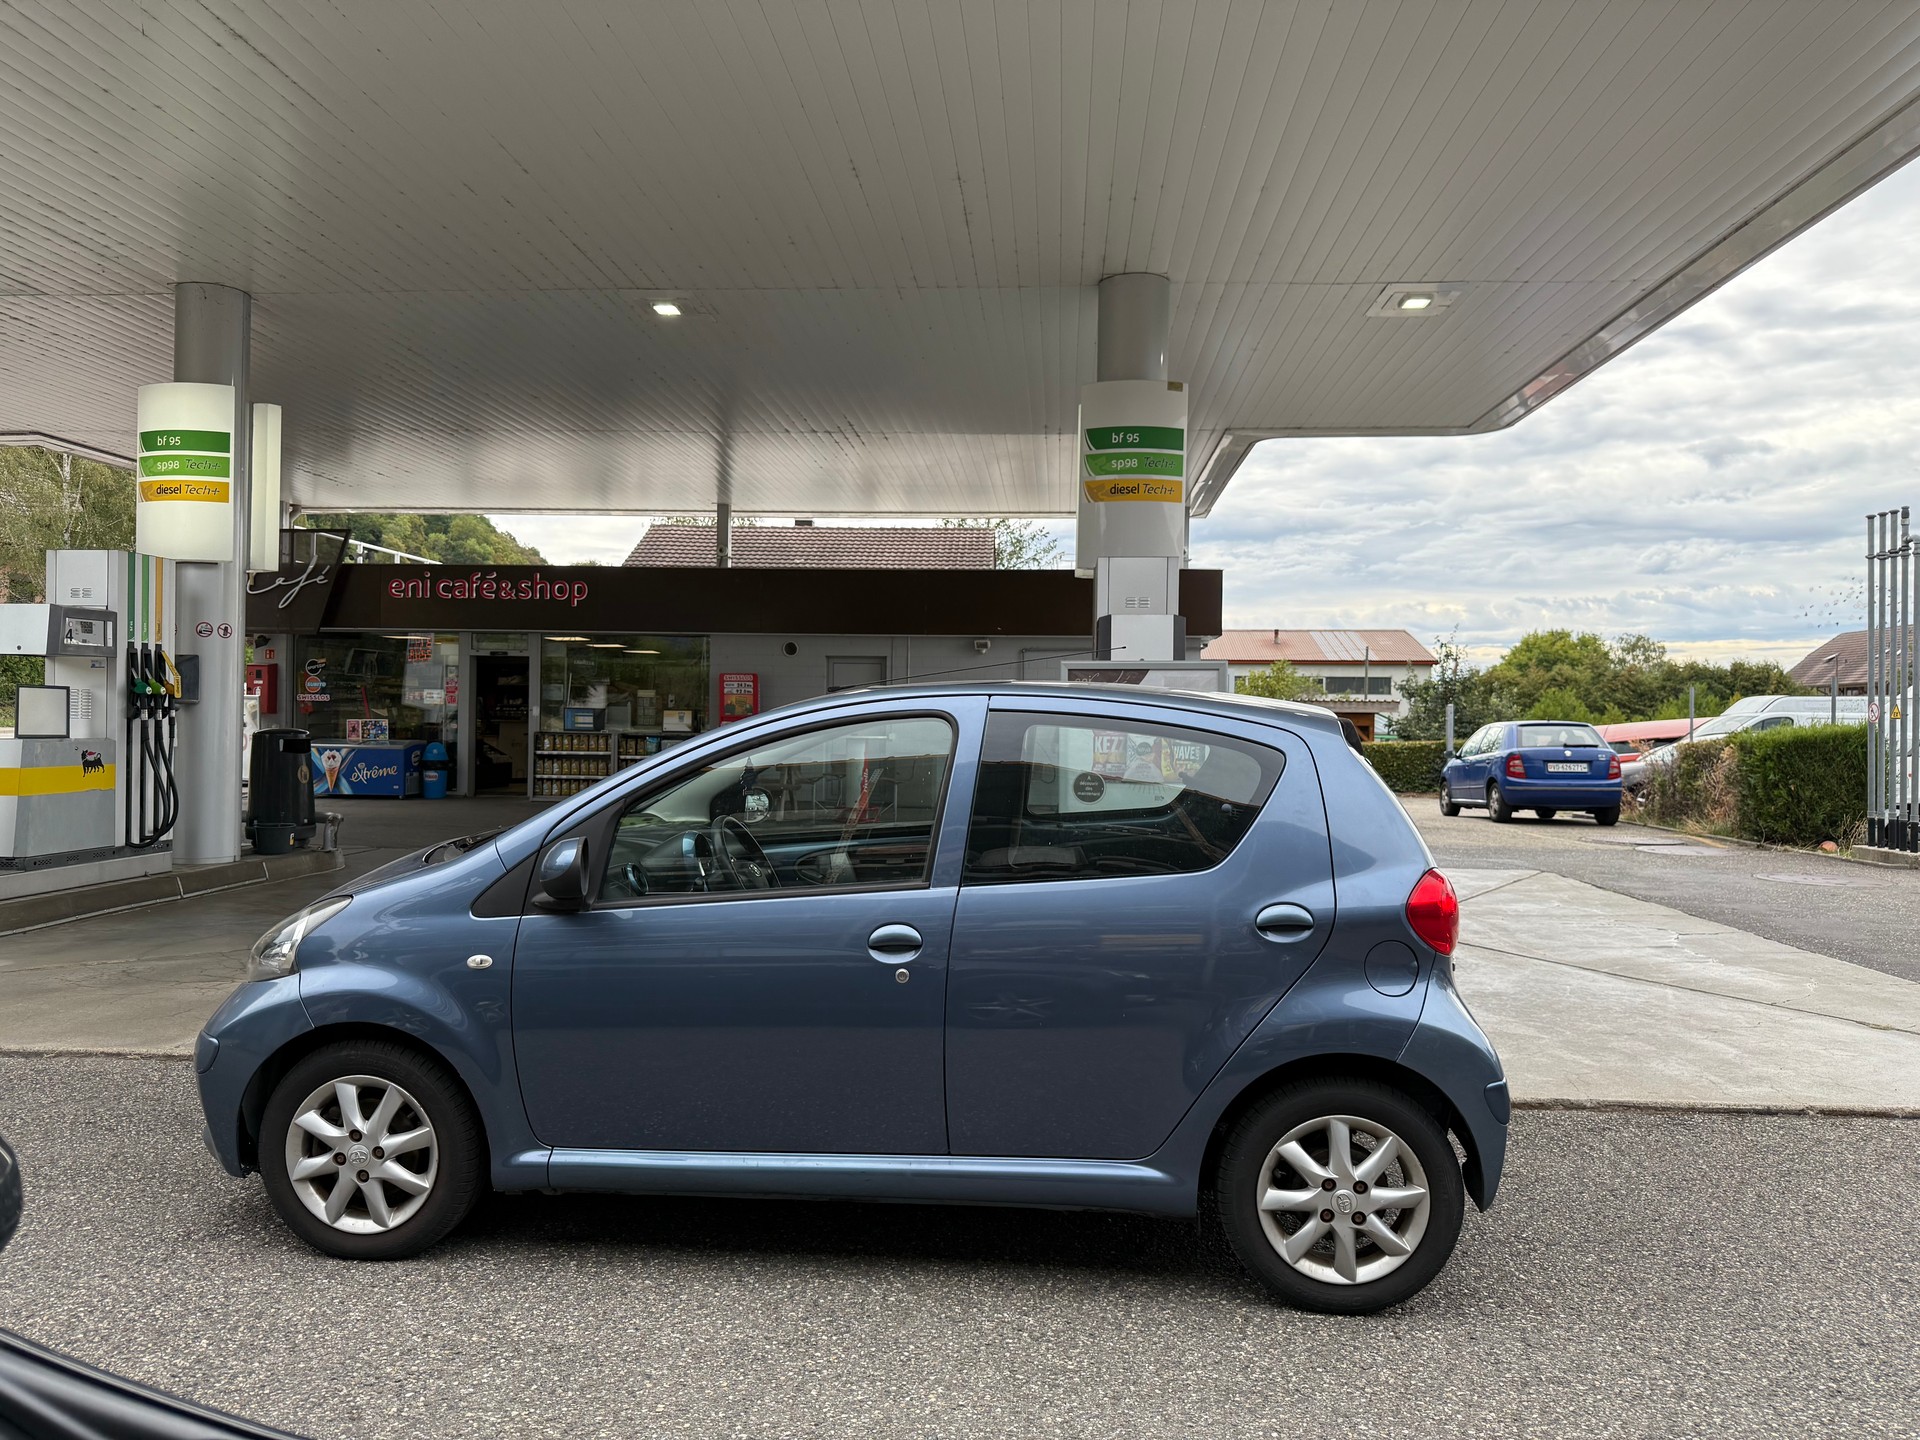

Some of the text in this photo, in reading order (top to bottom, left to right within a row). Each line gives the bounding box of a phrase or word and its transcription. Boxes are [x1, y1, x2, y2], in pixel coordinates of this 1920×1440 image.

[157, 435, 181, 446] bf 95
[1111, 432, 1140, 443] bf 95
[156, 458, 221, 472] sp98 Tech+
[1111, 457, 1176, 471] sp98 Tech+
[156, 483, 220, 496] diesel Tech+
[1109, 483, 1175, 495] diesel Tech+
[388, 570, 431, 599] eni
[65, 628, 74, 641] 4
[297, 693, 331, 701] SWISSLOS
